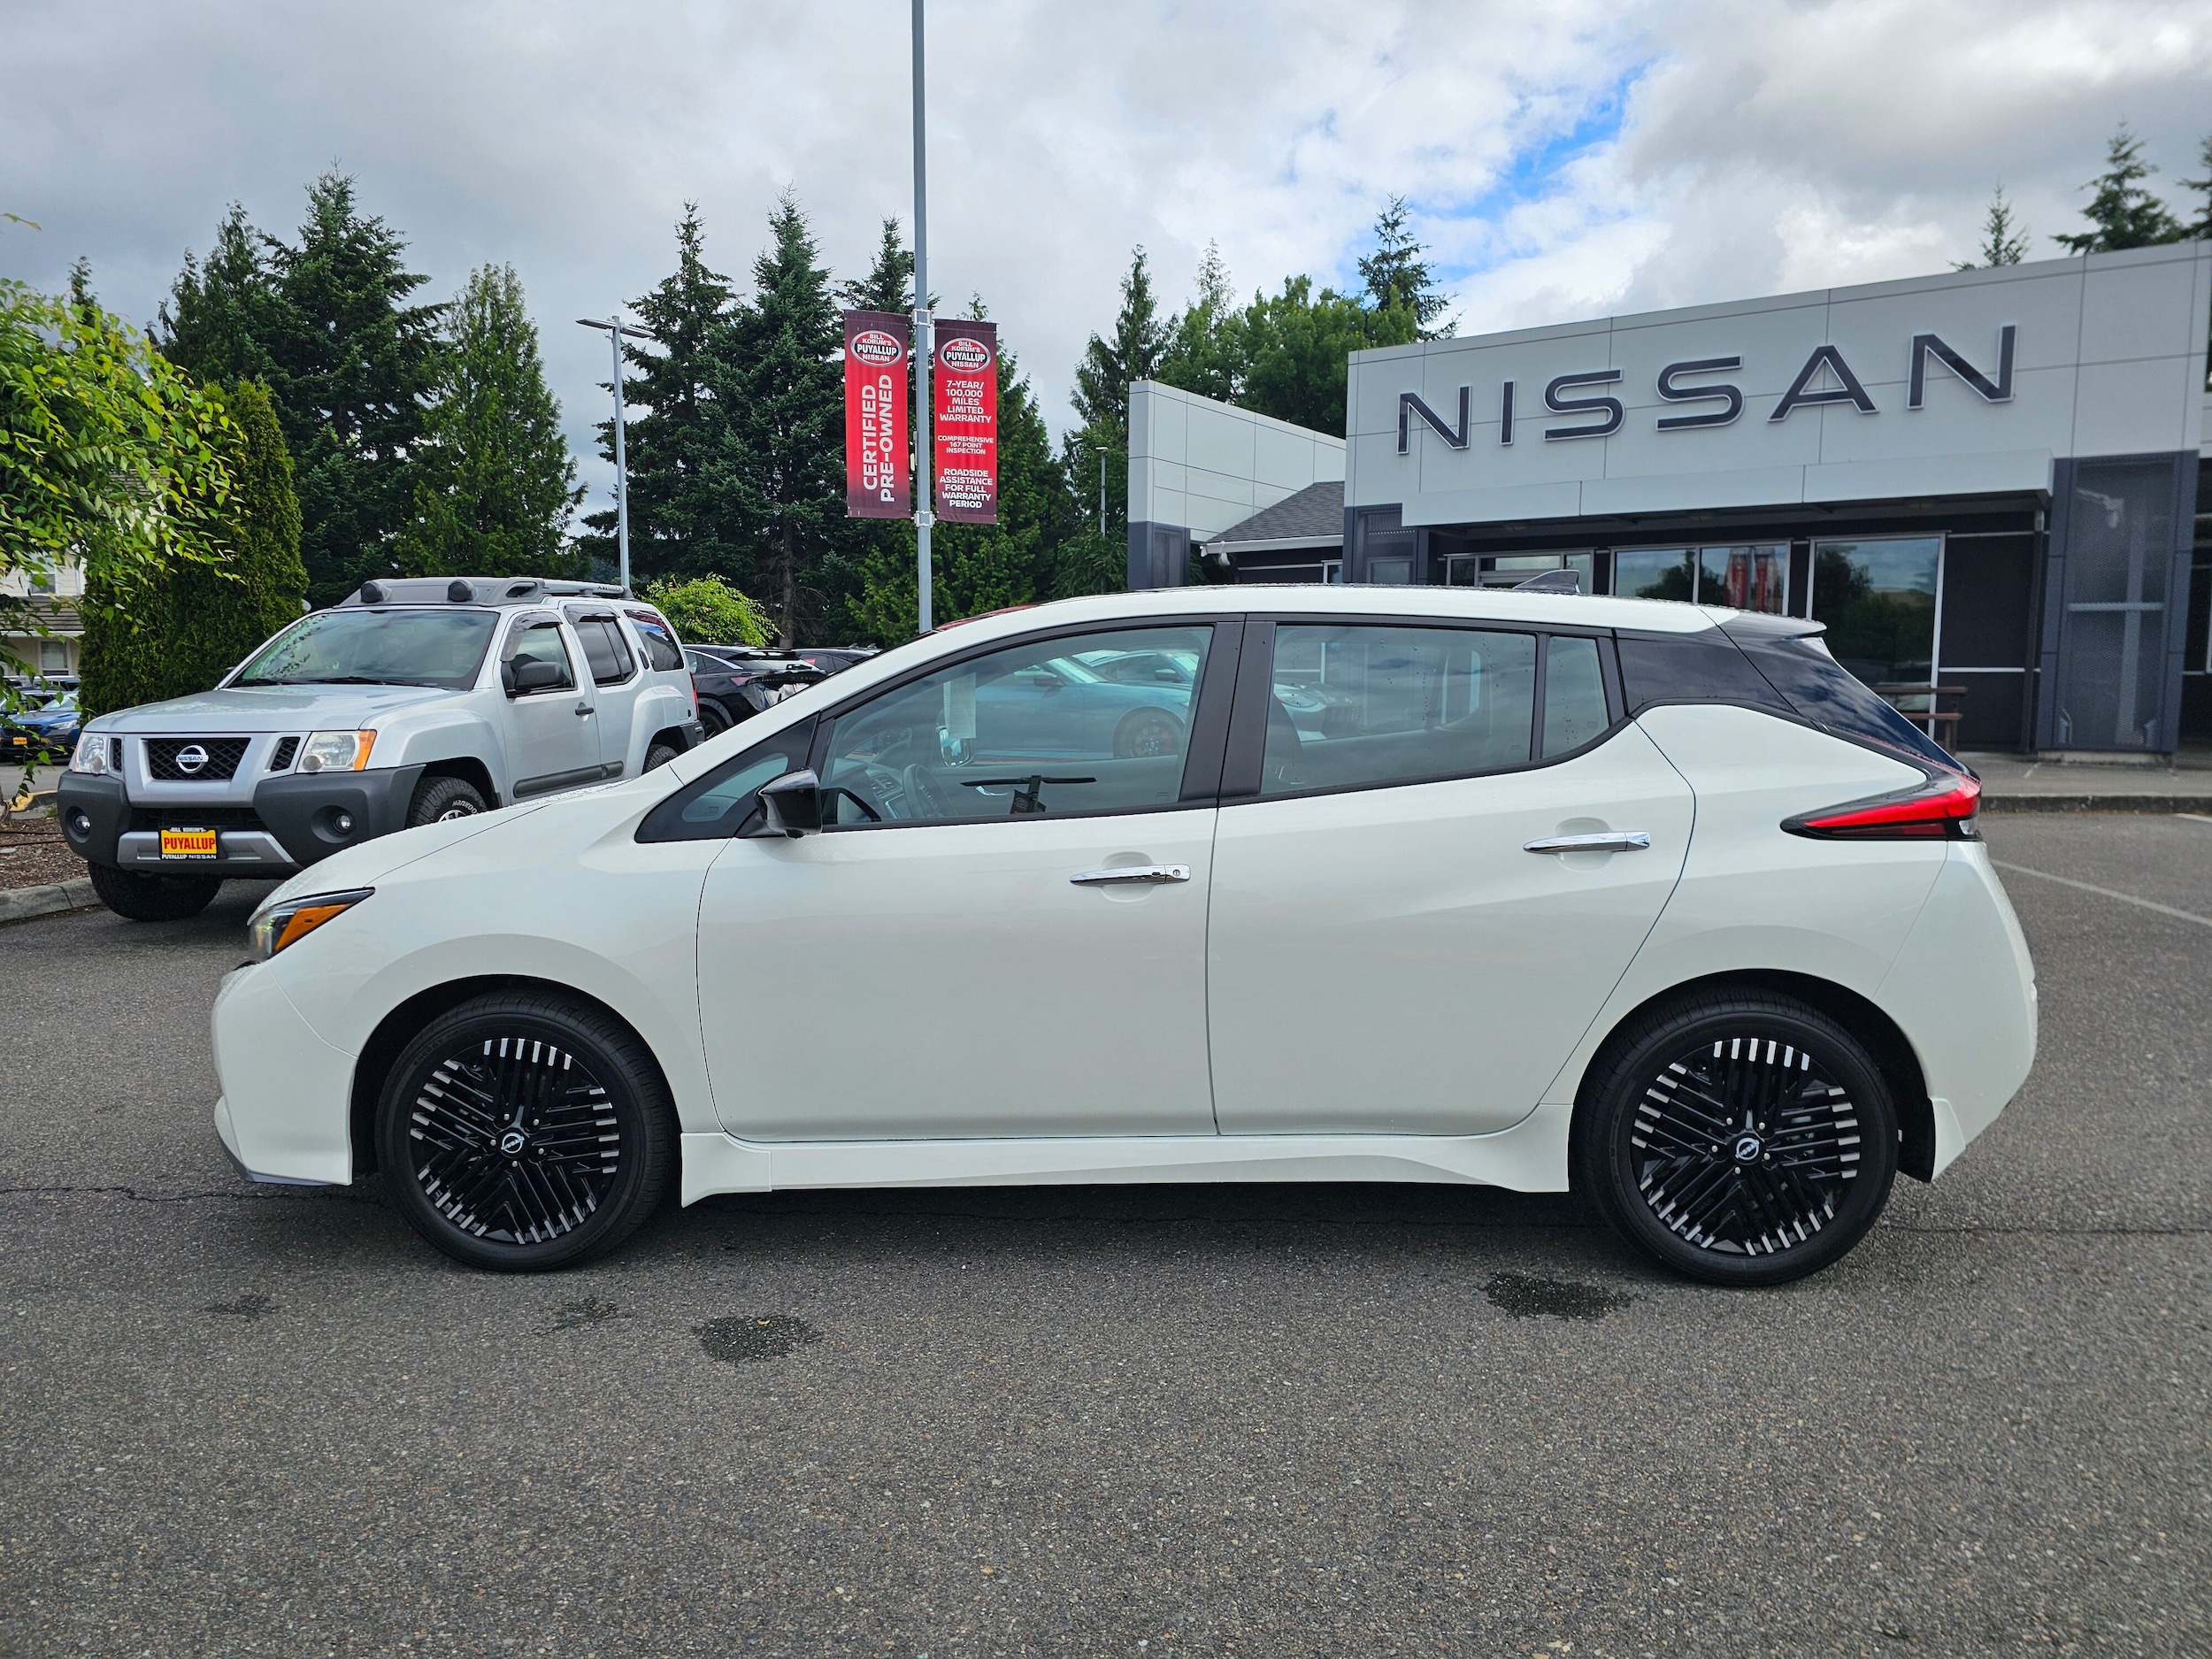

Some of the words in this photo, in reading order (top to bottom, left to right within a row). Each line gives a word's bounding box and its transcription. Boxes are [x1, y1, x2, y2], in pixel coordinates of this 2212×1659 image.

[856, 344, 897, 356] PUYALLUP
[946, 351, 986, 362] PUYALLUP
[946, 380, 985, 390] 7-YEAR/
[1396, 325, 2016, 455] NISSAN
[945, 388, 984, 398] 100,000
[951, 397, 979, 406] MILES
[947, 405, 984, 415] LIMITED
[939, 413, 992, 424] WARRANTY
[861, 384, 878, 490] CERTIFIED
[878, 374, 895, 503] PRE-OWNED
[937, 435, 995, 444] COMPREHENSIVE
[943, 468, 989, 478] ROADSIDE
[939, 476, 994, 486] ASSISTANCE
[965, 485, 987, 494] FULL
[941, 491, 992, 502] WARRANTY
[949, 499, 983, 509] PERIOD
[164, 837, 215, 850] PUYALLUP
